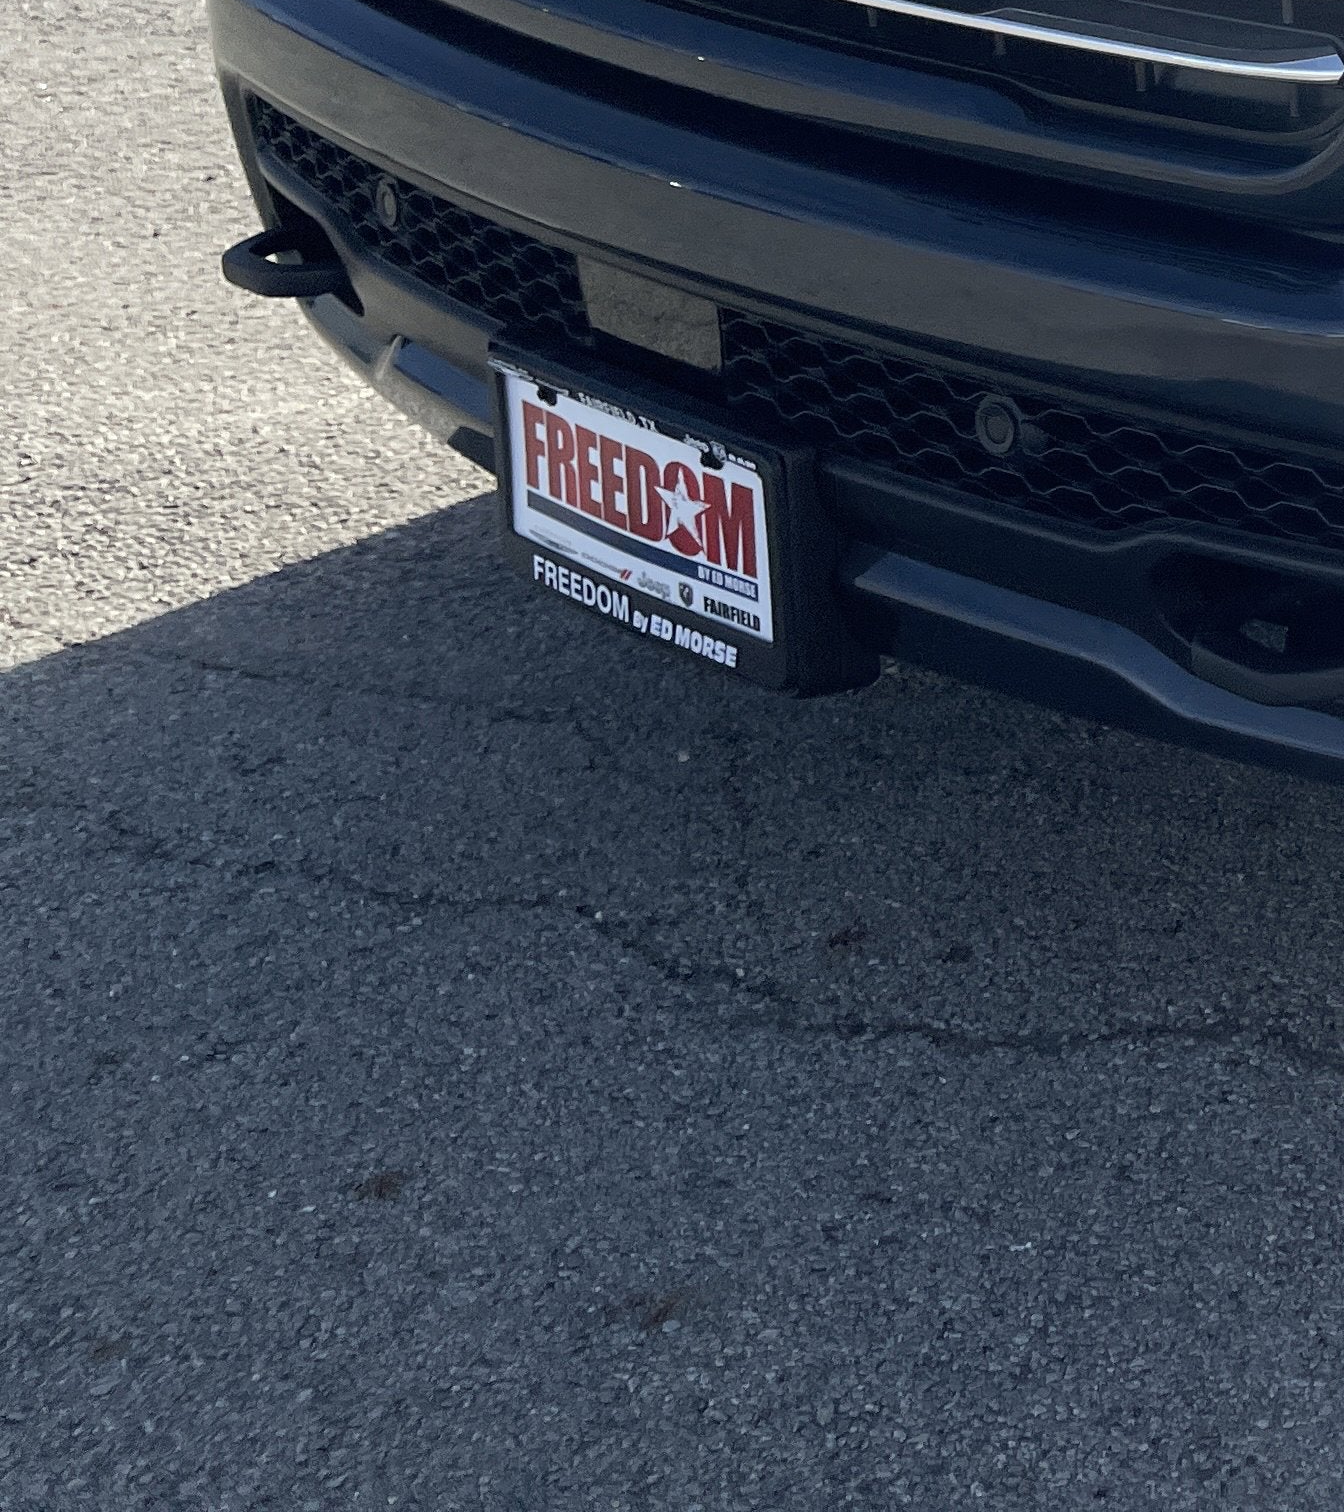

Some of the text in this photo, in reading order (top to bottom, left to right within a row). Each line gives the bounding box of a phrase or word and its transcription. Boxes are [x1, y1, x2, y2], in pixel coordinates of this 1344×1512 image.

[522, 400, 758, 579] FREEDOM
[533, 554, 630, 623] FREEDOM
[650, 614, 673, 642] ED
[675, 624, 738, 668] MORSE
[703, 596, 761, 632] FAIRFIELD
